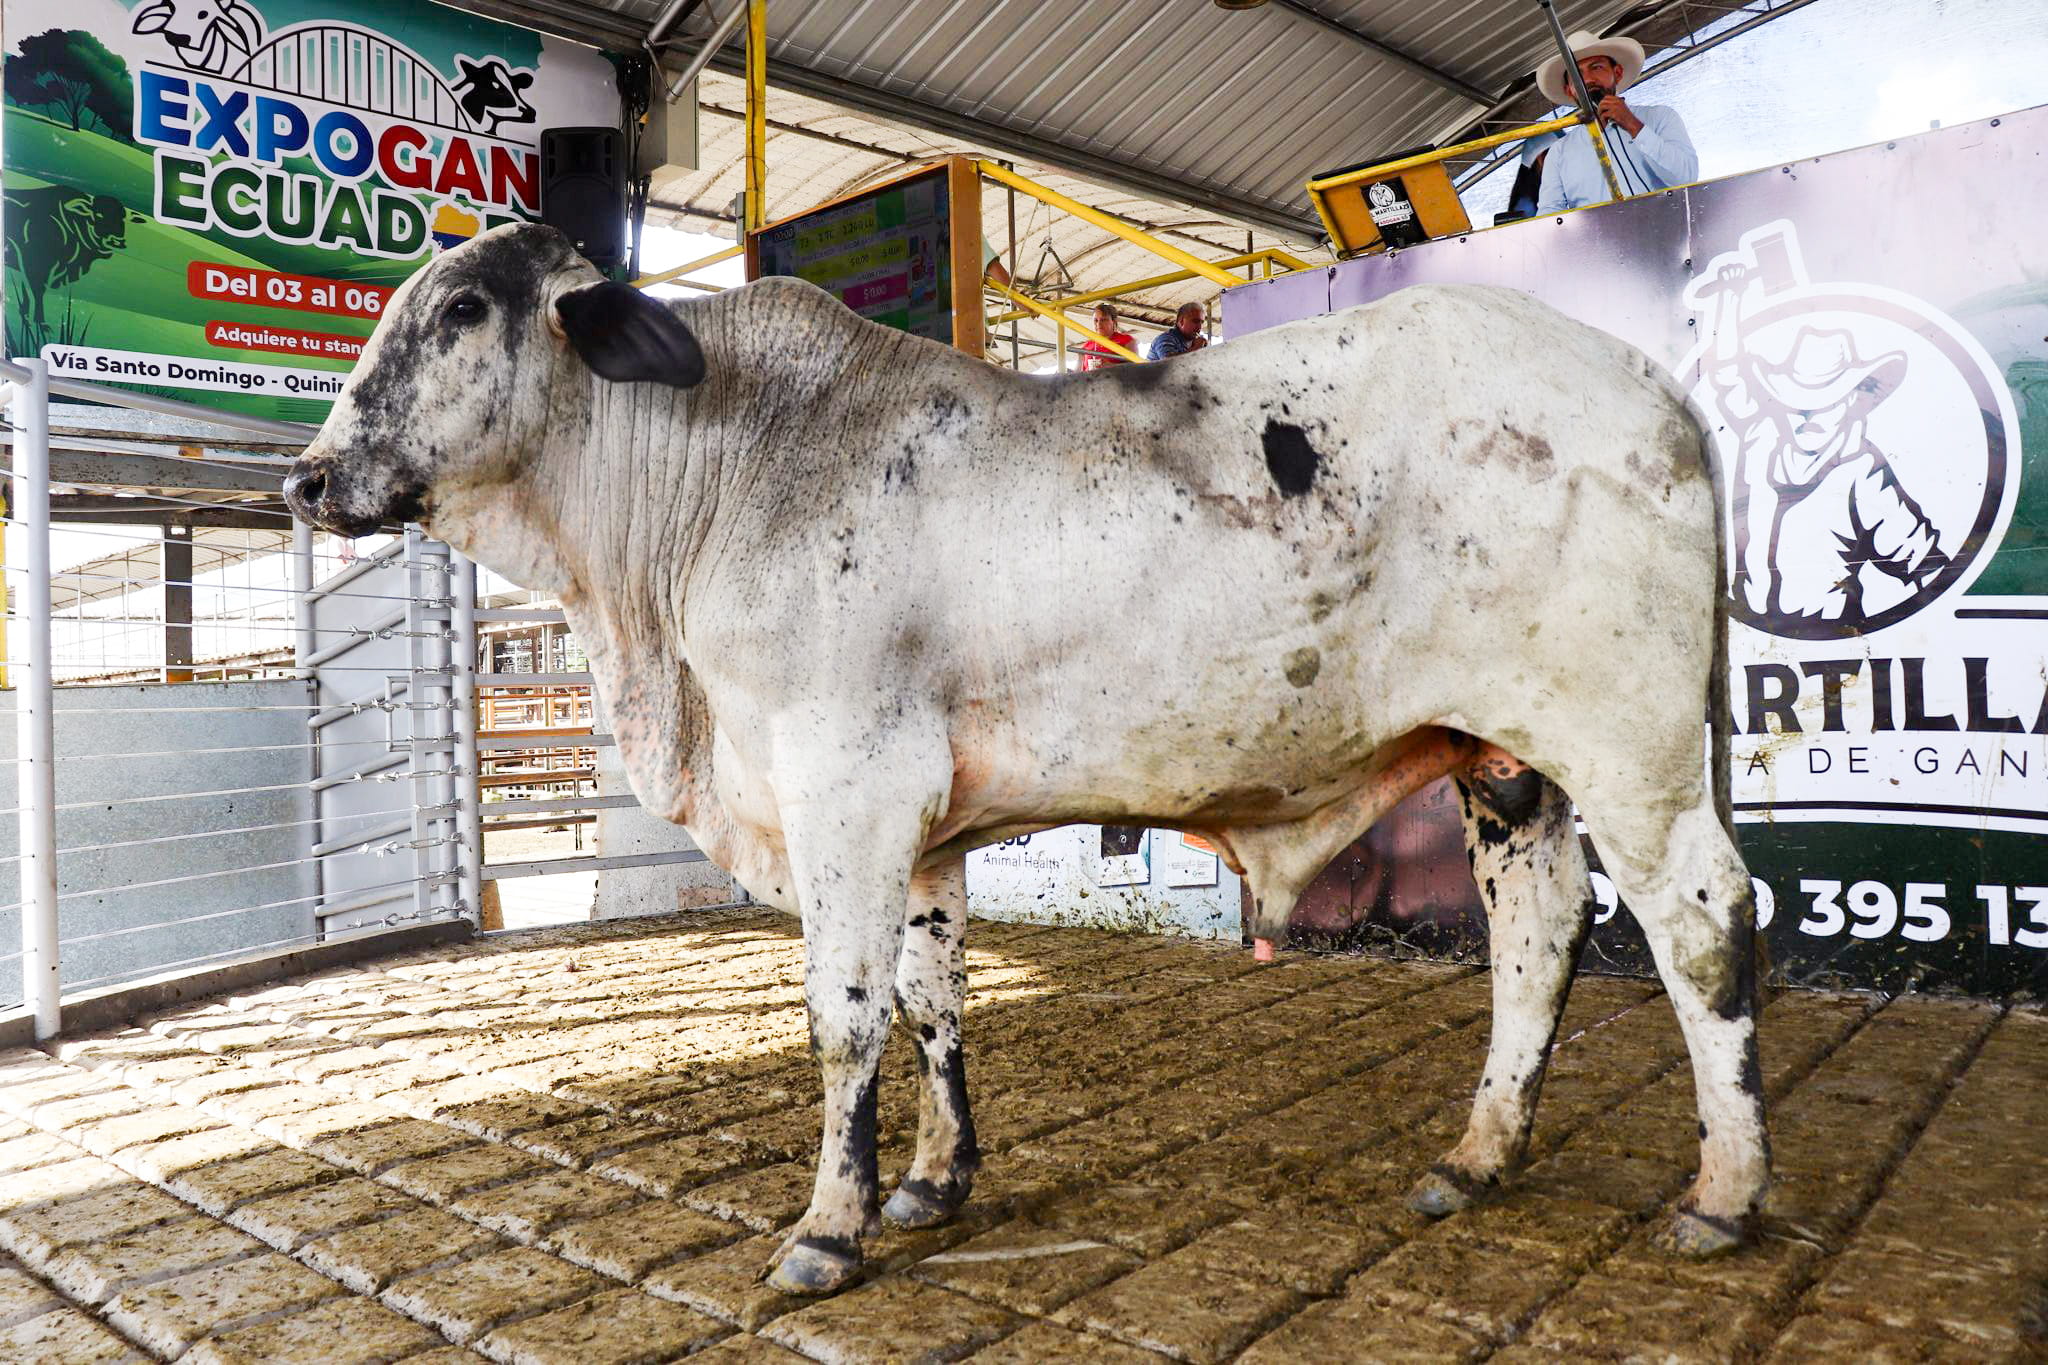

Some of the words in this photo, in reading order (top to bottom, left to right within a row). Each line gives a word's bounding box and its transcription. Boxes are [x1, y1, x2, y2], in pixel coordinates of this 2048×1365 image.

[139, 70, 541, 211] EXPOGAN
[205, 269, 257, 297] Del
[266, 278, 302, 303] 03
[311, 284, 336, 308] al
[345, 288, 381, 313] 06
[214, 326, 297, 347] Adquiere
[302, 337, 320, 351] tu
[325, 338, 362, 355] stan
[51, 351, 88, 371] Vía
[95, 355, 160, 377] Santo
[168, 363, 265, 389] Domingo
[1728, 656, 2048, 735] RTILL
[1808, 747, 1870, 775] DE
[983, 853, 1020, 867] Animal
[1024, 855, 1060, 870] Health
[1799, 879, 1951, 943] 395
